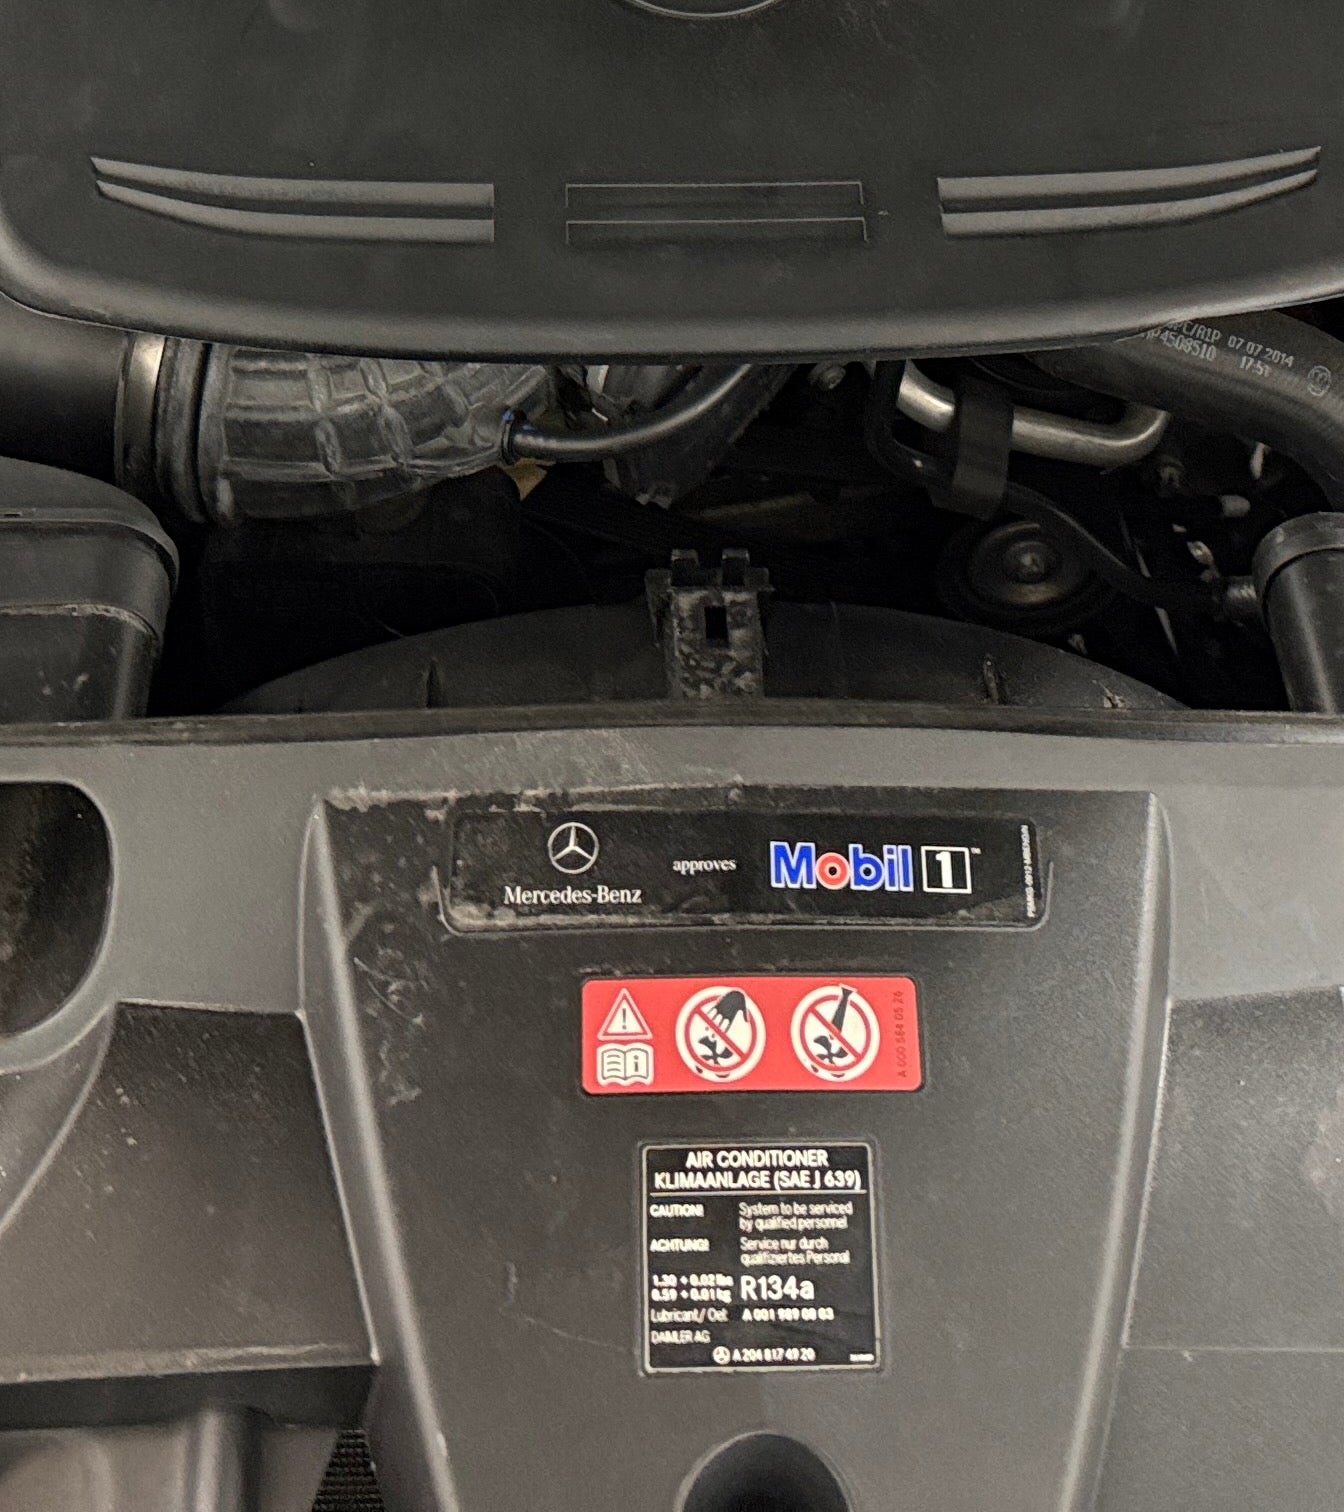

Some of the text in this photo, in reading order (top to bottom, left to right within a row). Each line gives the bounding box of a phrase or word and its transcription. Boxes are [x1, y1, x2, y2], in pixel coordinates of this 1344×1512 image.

[672, 858, 737, 876] approves
[769, 840, 914, 892] Mobil
[503, 884, 643, 906] Mercedes-Benz
[685, 1149, 829, 1169] AIR CONDITIONER
[654, 1169, 862, 1192] KLIMAANLAGE (SAE J 639)
[649, 1203, 704, 1218] CAUTION!
[738, 1200, 854, 1219] System to be serviced
[738, 1215, 848, 1233] by qualified personnel
[649, 1238, 710, 1252] ACHTUNG!
[739, 1236, 829, 1251] Service nur durch
[739, 1250, 851, 1268] qualifiziertes Personal
[740, 1275, 815, 1301] R134a
[742, 1308, 753, 1321] A
[650, 1329, 711, 1345] DAIMLER AG
[732, 1349, 742, 1362] A
